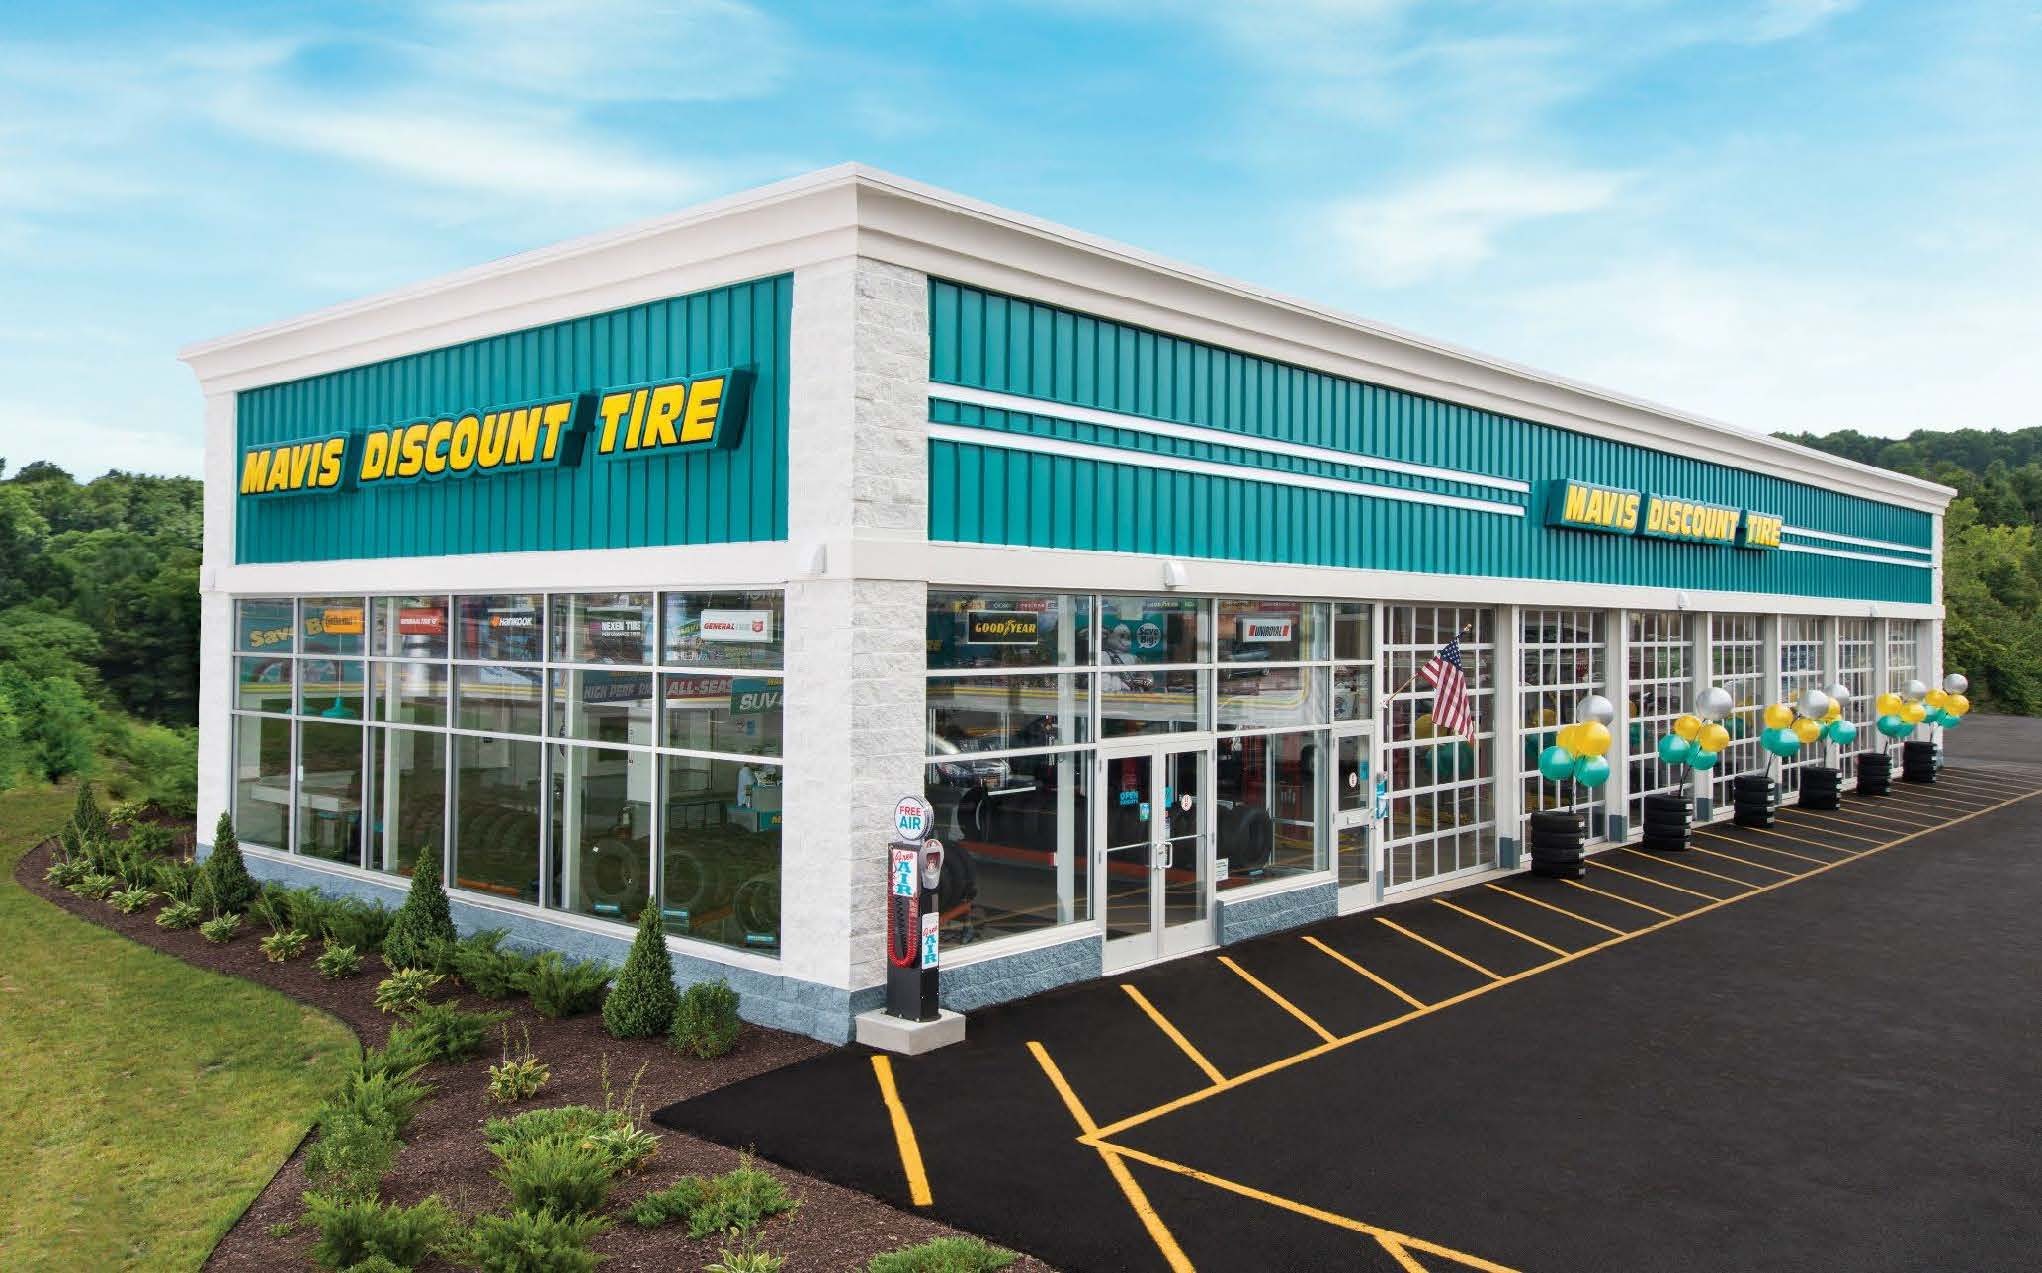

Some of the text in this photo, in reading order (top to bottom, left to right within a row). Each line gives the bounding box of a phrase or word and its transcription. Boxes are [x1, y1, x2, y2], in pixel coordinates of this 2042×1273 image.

[240, 378, 725, 495] MAVIS DISCOUNT TIRE
[1564, 483, 1783, 548] MAVIS DISCOUNT TIRE
[703, 622, 735, 631] GENERAL
[975, 618, 1037, 637] GOODYEAR
[1254, 624, 1283, 637] UNIROYAL
[899, 806, 922, 816] FREE
[899, 816, 921, 830] AIR
